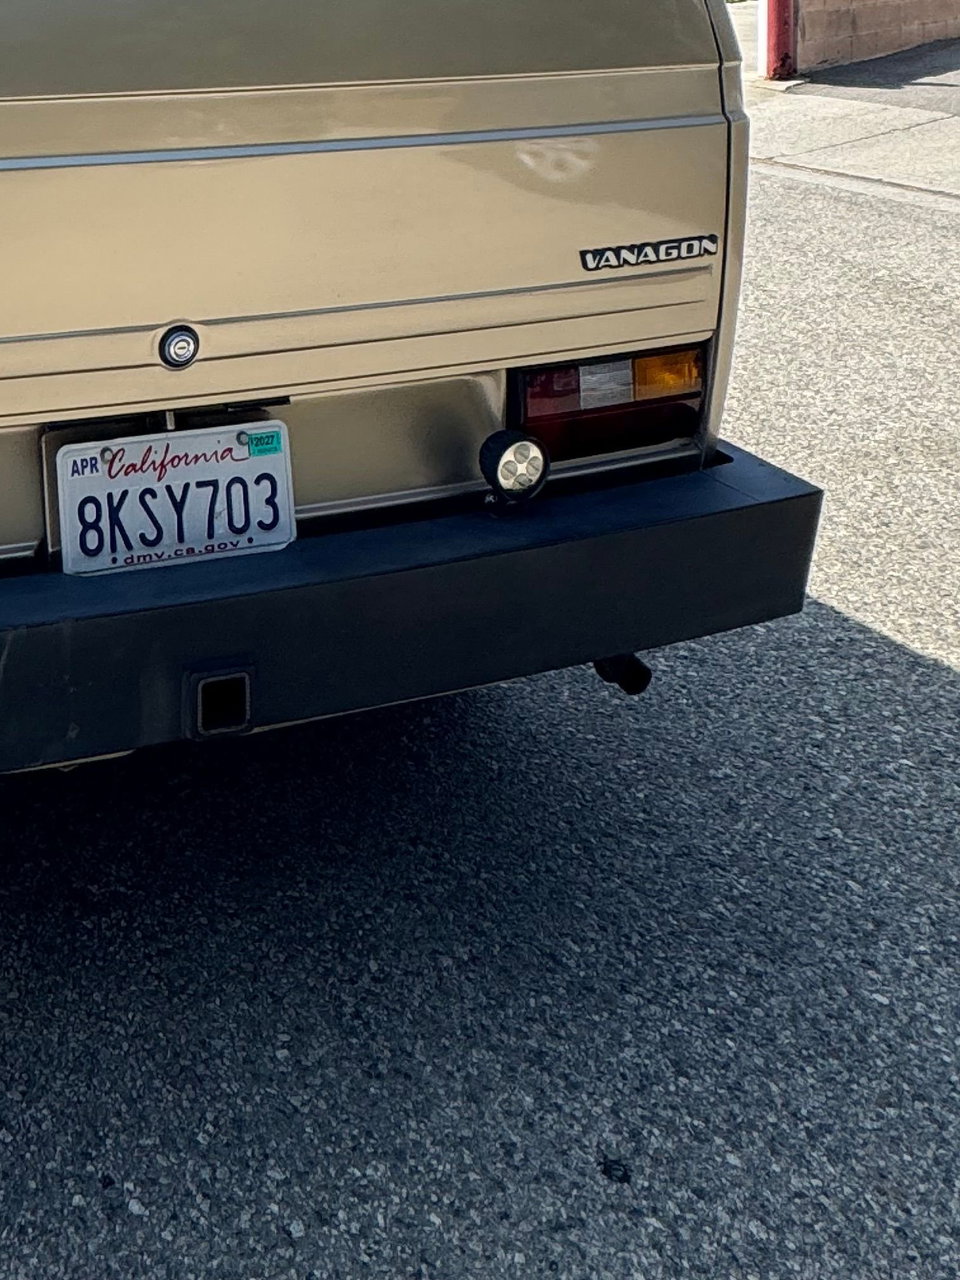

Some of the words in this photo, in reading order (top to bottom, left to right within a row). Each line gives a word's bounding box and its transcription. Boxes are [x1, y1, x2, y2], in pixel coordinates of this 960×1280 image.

[585, 239, 717, 269] VANAGON
[253, 435, 274, 446] 2027
[71, 456, 99, 477] APR
[107, 443, 251, 482] California
[77, 472, 280, 557] 8KSY703
